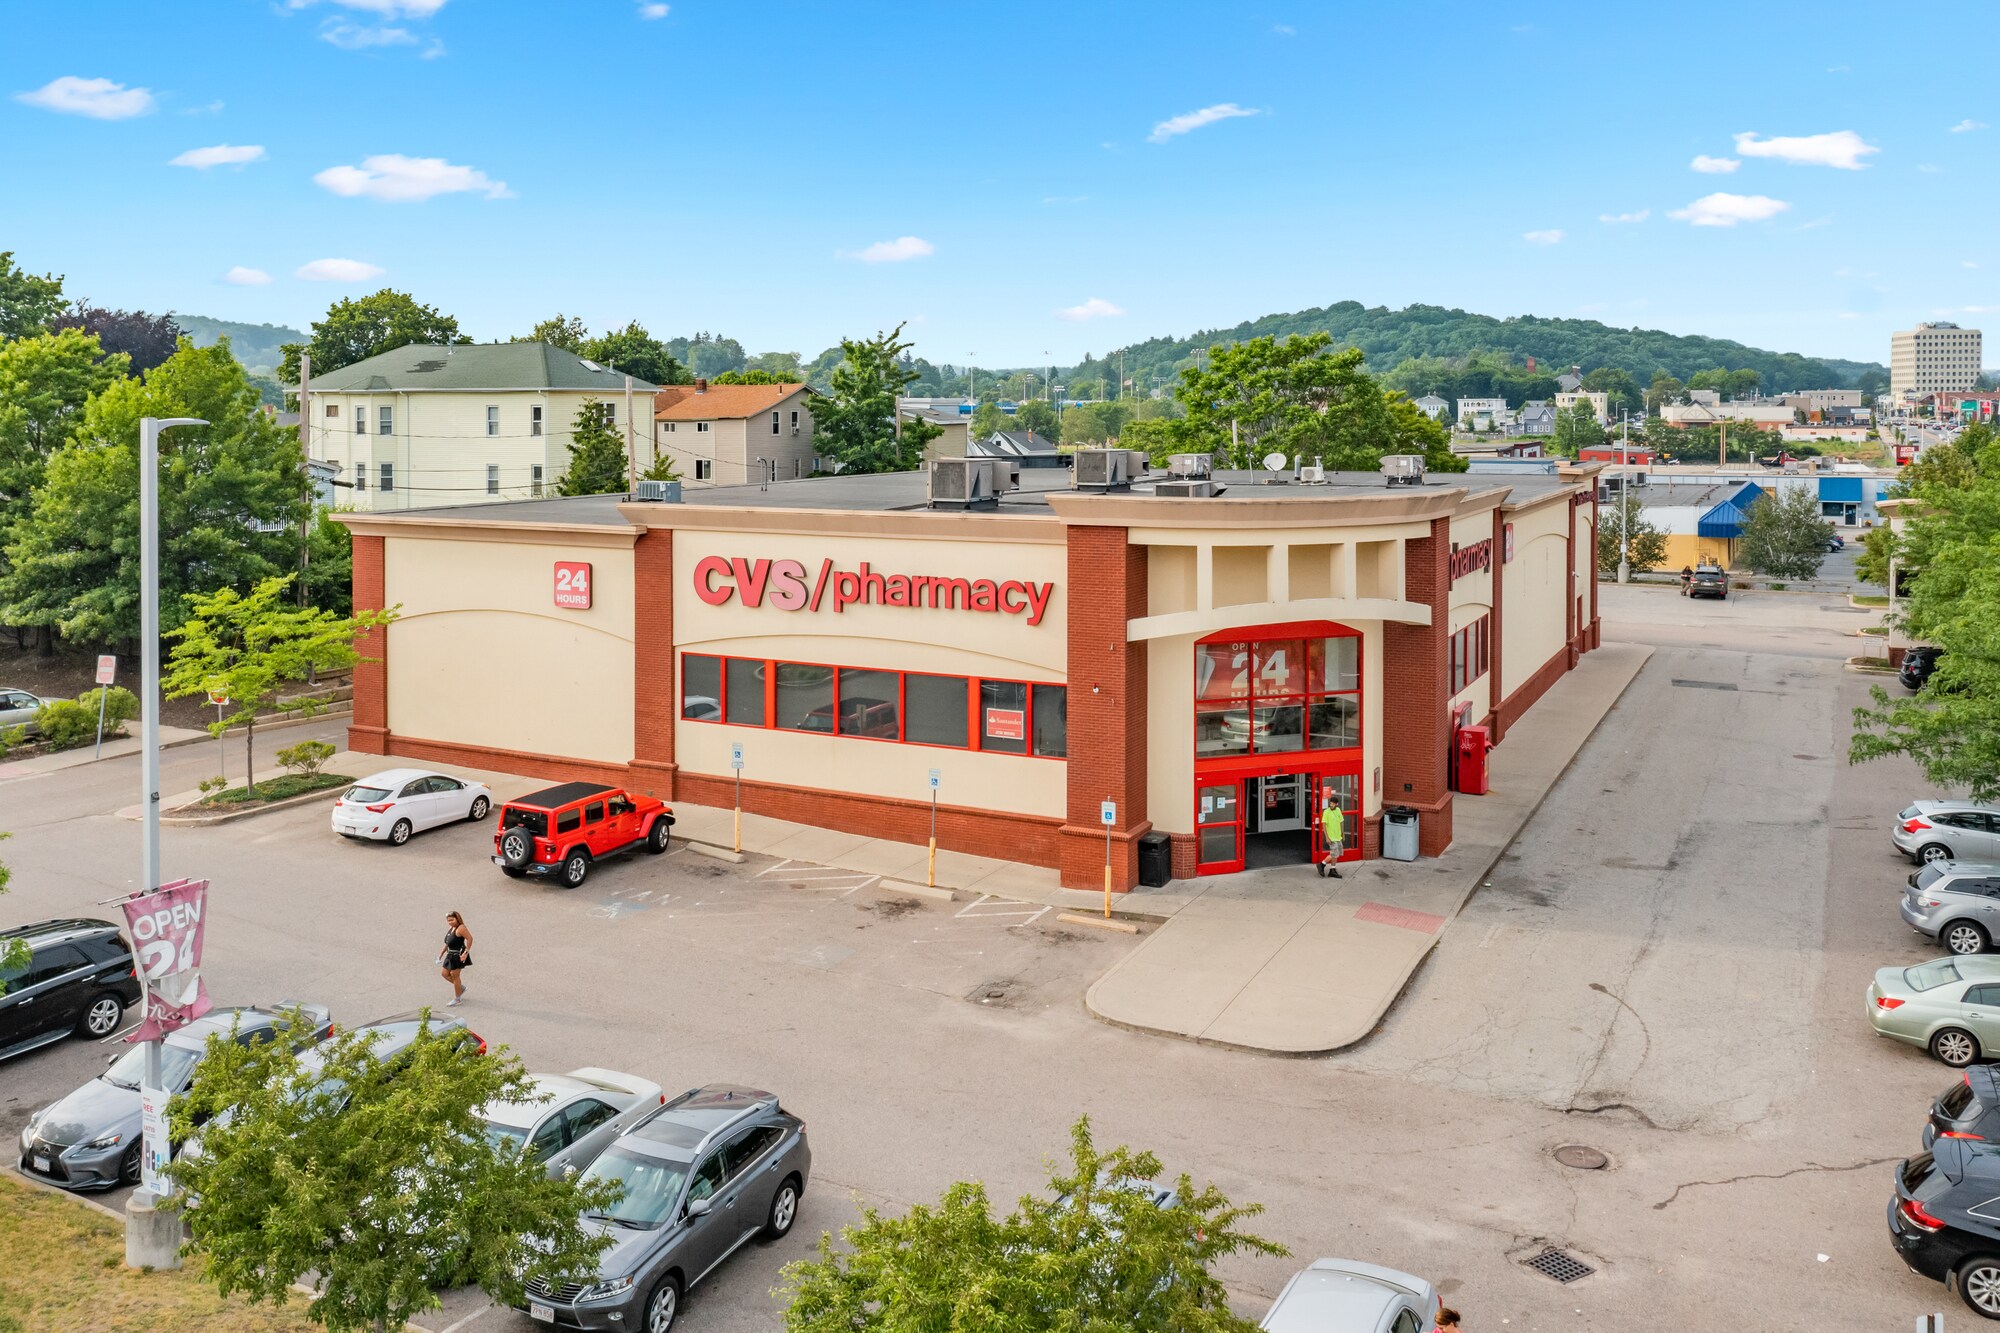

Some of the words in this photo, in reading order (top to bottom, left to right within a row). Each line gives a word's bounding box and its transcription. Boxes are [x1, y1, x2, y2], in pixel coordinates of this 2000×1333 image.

[1449, 538, 1492, 591] pharmacy
[557, 568, 587, 592] 24
[556, 594, 587, 604] HOURS
[1232, 642, 1259, 651] OPN
[1231, 650, 1290, 688] 24
[1231, 688, 1290, 704] HURS
[996, 717, 1022, 725] Santander
[132, 899, 201, 940] OPEN
[138, 928, 197, 981] 24
